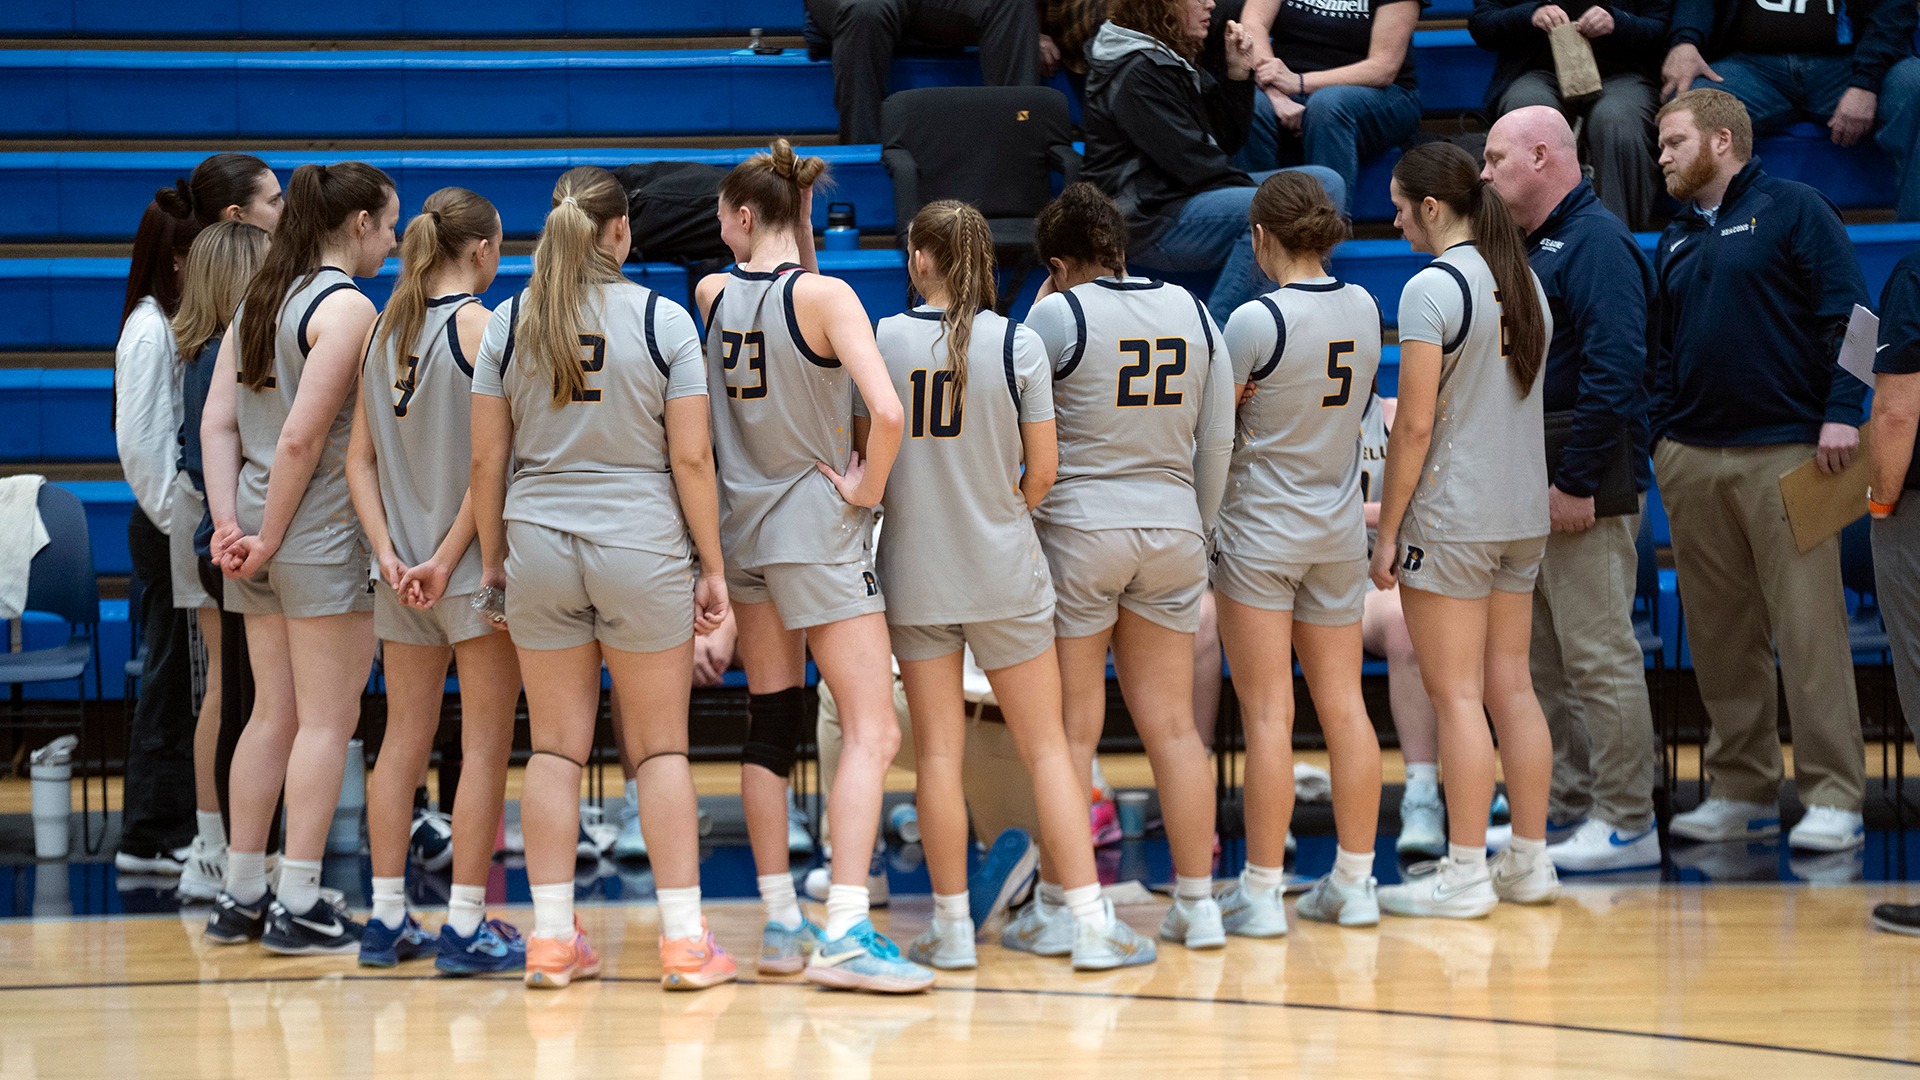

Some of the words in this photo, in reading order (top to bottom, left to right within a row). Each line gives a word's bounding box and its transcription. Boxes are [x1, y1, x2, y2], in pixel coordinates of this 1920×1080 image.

[1286, 1, 1370, 19] UNIVERSITY
[722, 328, 769, 400] 23
[1116, 335, 1189, 409] 22
[1321, 339, 1356, 408] 5
[908, 367, 966, 440] 10
